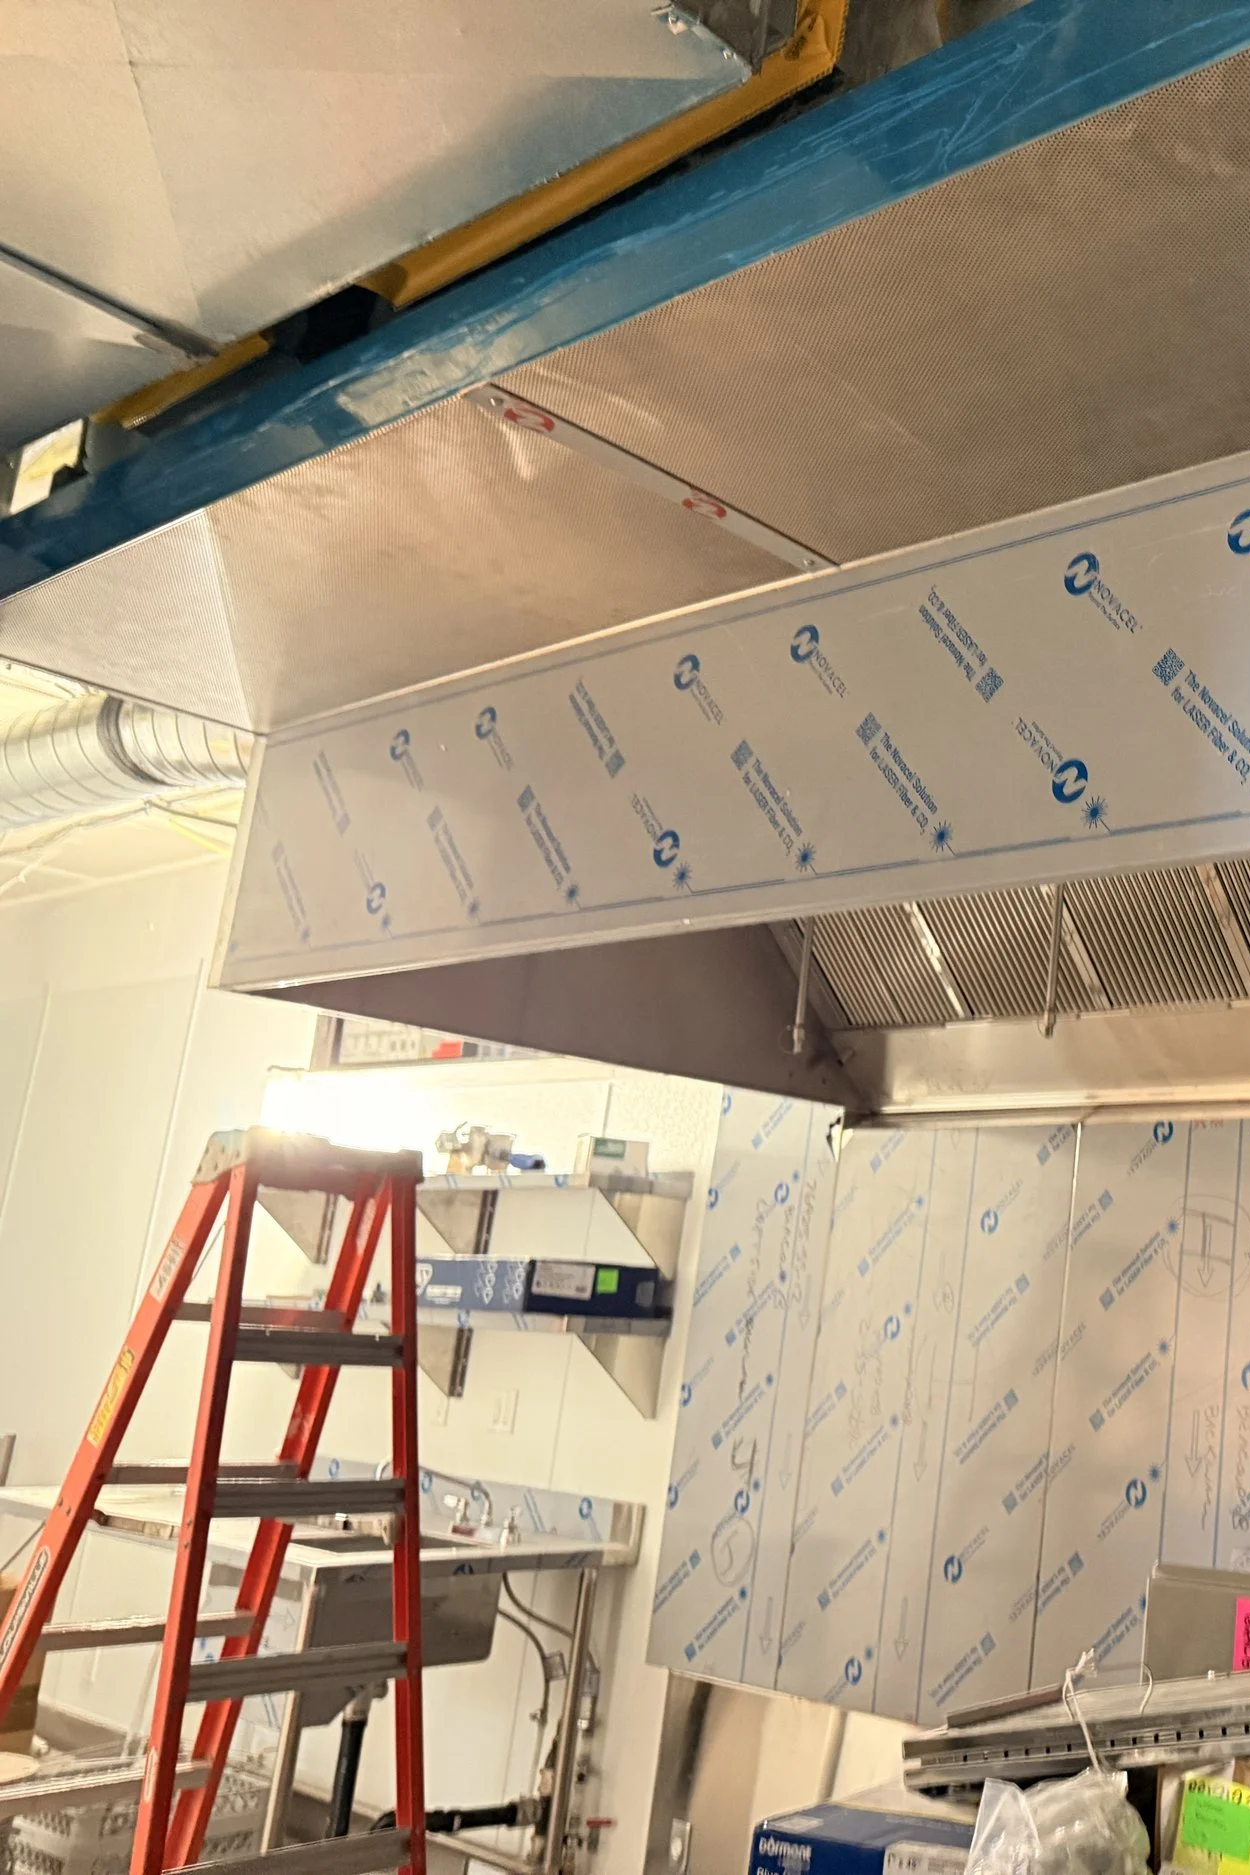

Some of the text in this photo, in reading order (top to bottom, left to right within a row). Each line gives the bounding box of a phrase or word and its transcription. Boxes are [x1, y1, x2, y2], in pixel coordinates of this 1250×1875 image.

[941, 608, 959, 631] Fiber
[1088, 580, 1138, 633] NOVACEL
[918, 604, 976, 682] The Novacel Solution
[955, 627, 978, 651] LASER
[975, 651, 987, 667] for
[1170, 685, 1184, 703] for
[1182, 699, 1210, 732] LASER
[1206, 726, 1229, 753] Fiber
[1183, 669, 1201, 692] The
[1197, 686, 1231, 724] Novacel
[1014, 716, 1062, 773] NOVACEL
[868, 746, 881, 762] for
[877, 763, 899, 788] LASER
[895, 784, 913, 807] Fiber
[879, 731, 937, 814] The Novacel Solution
[758, 1835, 812, 1862] Dormont
